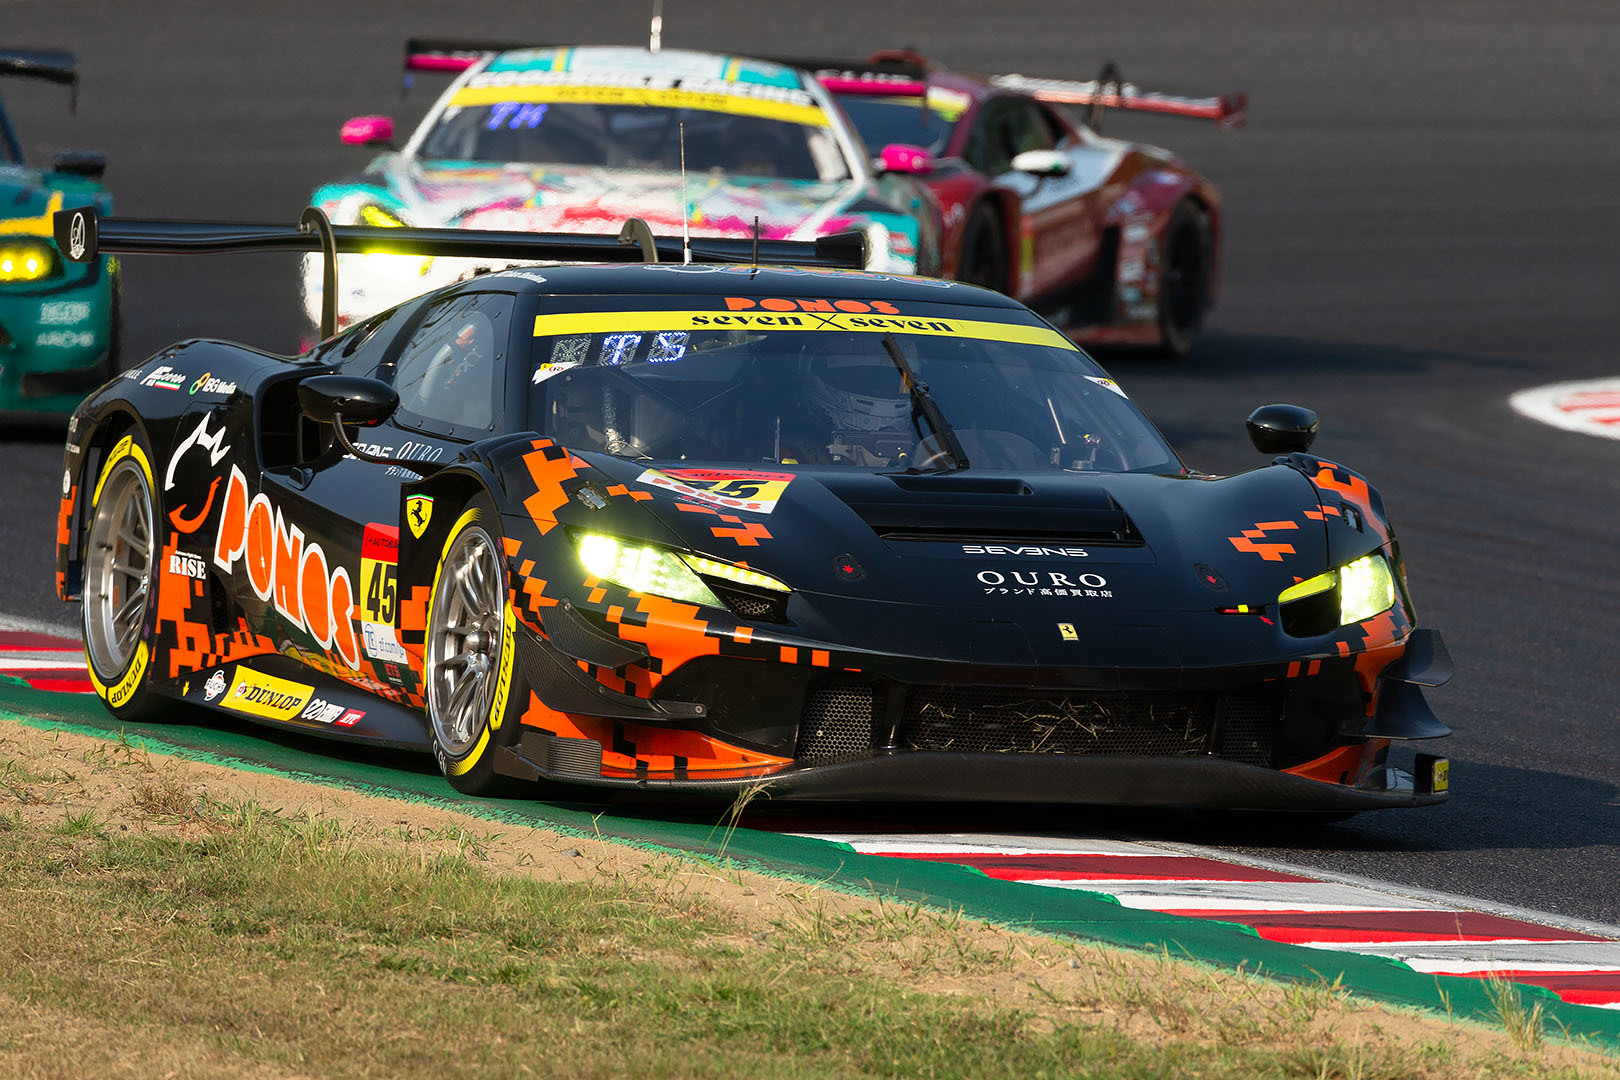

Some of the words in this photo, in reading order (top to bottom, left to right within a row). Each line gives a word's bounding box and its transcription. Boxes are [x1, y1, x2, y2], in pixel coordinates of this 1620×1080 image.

[724, 297, 900, 314] PONOS
[692, 313, 804, 327] seven
[849, 317, 956, 333] seven
[651, 477, 762, 510] PONOS
[169, 555, 206, 580] RISE
[213, 463, 361, 671] PONOS
[976, 570, 1107, 588] OURO
[367, 562, 398, 624] 45
[111, 657, 142, 704] DUNLOP
[494, 624, 512, 722] DUNLOP
[205, 679, 226, 694] FUCHS
[245, 686, 302, 711] DUNLOP
